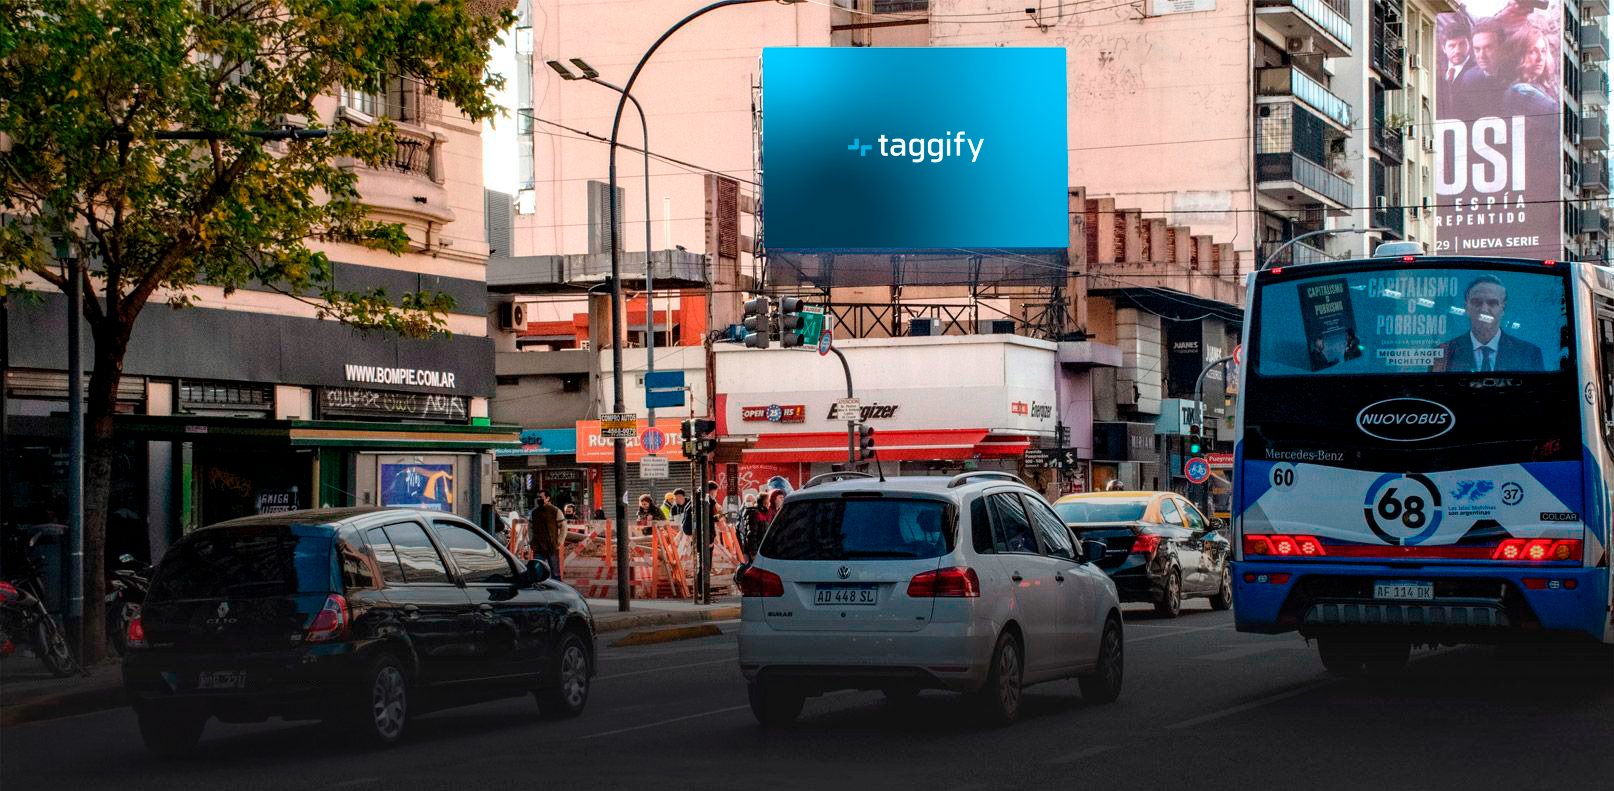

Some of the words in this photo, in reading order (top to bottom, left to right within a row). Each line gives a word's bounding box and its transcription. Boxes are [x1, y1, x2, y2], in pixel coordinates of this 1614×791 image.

[878, 131, 984, 163] taggify
[1456, 192, 1526, 212] ESPÍA
[1436, 240, 1450, 250] 29
[1462, 238, 1503, 250] NUEVA
[1506, 236, 1540, 248] SERIE
[1307, 283, 1344, 298] CAPITALISMO
[1368, 277, 1459, 298] CAPITALISMO
[1408, 300, 1416, 313] O
[1376, 314, 1447, 336] POBRISMO
[1173, 341, 1198, 350] JUANES
[345, 364, 456, 388] WWW.BOMPIE.COM.AR
[744, 410, 764, 418] OPEN
[1031, 400, 1052, 422] Energizer
[1362, 412, 1448, 426] NUOVOBUS
[1265, 449, 1344, 461] Mercedes-Benz
[1273, 468, 1294, 486] 60
[262, 494, 289, 504] AMIGA
[1504, 489, 1519, 500] 37
[1377, 488, 1426, 528] 68
[1542, 513, 1578, 521] COLCAR
[817, 590, 831, 602] AD
[835, 590, 856, 602] 448
[860, 590, 874, 602] SL
[1377, 587, 1391, 598] AF
[1394, 587, 1413, 598] 114
[1417, 587, 1430, 598] DK
